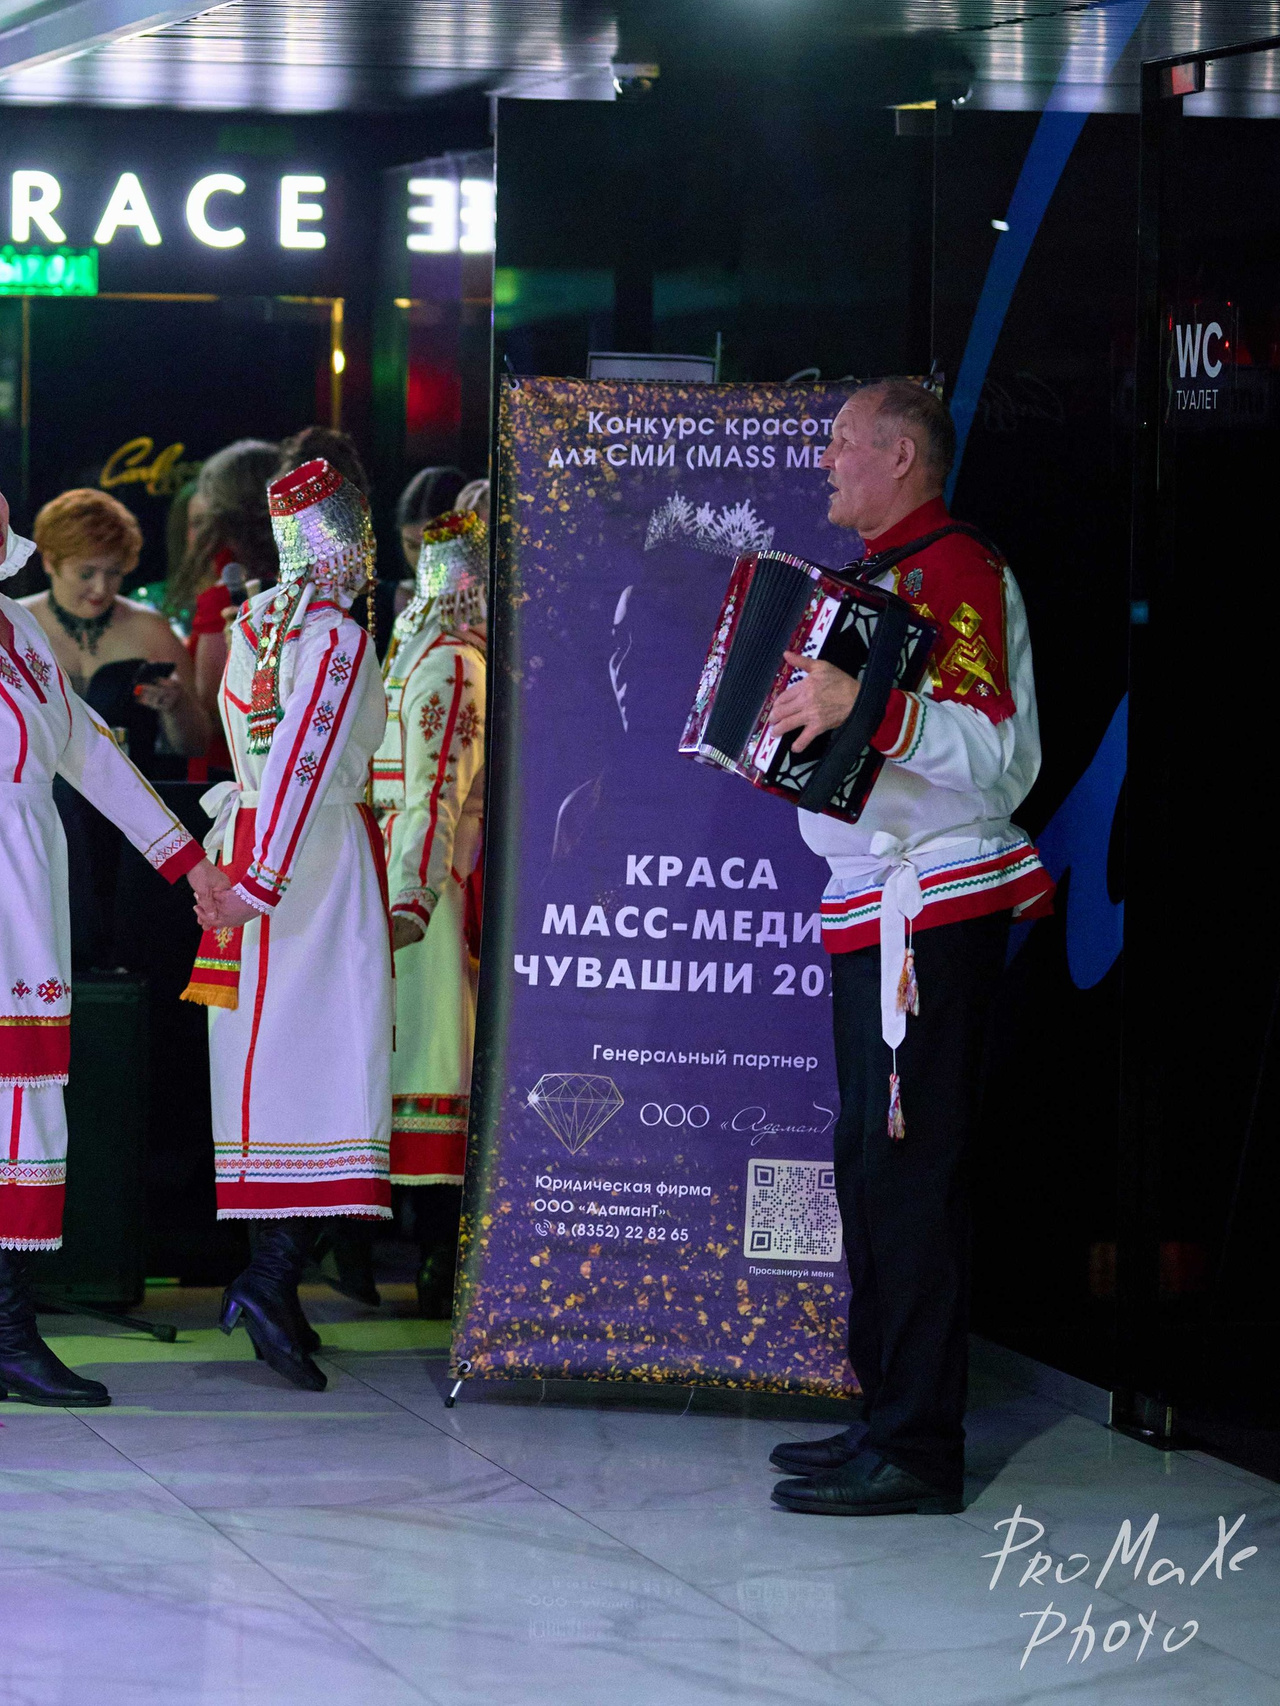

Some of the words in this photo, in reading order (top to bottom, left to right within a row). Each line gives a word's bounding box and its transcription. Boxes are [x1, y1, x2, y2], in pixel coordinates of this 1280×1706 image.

[1176, 321, 1223, 378] WC
[1176, 389, 1219, 410] ТУАЛЕТ
[588, 411, 715, 440] Конкурс
[725, 418, 833, 440] красот
[548, 448, 597, 468] для
[606, 444, 675, 467] СМИ
[686, 445, 776, 470] (MASS
[786, 446, 826, 468] ME
[625, 854, 778, 890] КРАСА
[541, 903, 821, 948] МАСС-МЕДИ
[513, 954, 753, 994] ЧУВАШИИ
[771, 963, 833, 998] 20
[592, 1044, 727, 1066] Генеральный
[733, 1053, 819, 1072] партнер
[640, 1102, 710, 1128] ООО
[535, 1175, 651, 1193] Юридическая
[656, 1181, 712, 1198] фирма
[534, 1199, 574, 1213] ООО
[557, 1222, 566, 1235] 8
[571, 1223, 620, 1239] (8352)
[625, 1226, 643, 1239] 22
[648, 1227, 666, 1240] 82
[670, 1228, 689, 1242] 65
[749, 1266, 809, 1278] Просканируй
